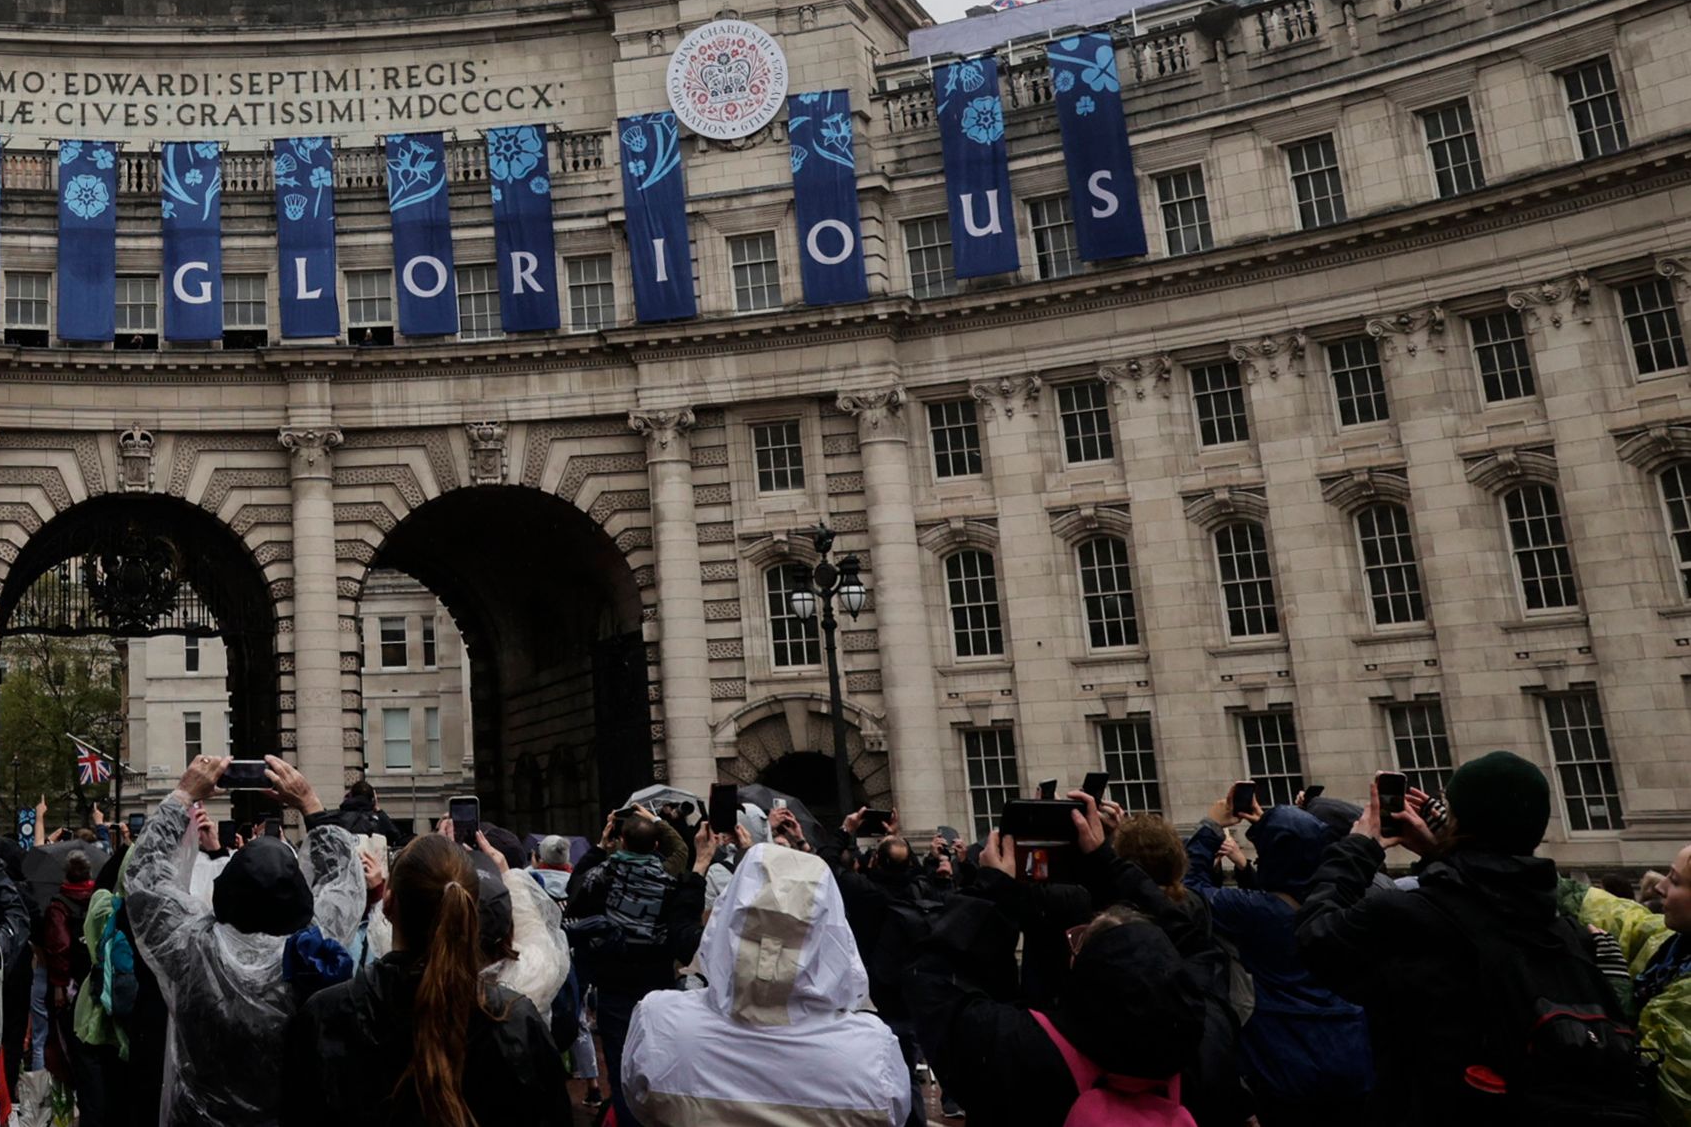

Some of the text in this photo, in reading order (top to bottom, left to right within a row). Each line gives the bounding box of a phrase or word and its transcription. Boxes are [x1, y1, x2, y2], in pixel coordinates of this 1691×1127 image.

[676, 24, 773, 66] KING CHARLES III
[63, 72, 211, 97] EDWARDI
[229, 69, 359, 96] SEPTIMI
[383, 59, 477, 91] REGIS
[740, 59, 784, 132] 6TH MAY 2023
[55, 102, 159, 127] CIVES
[176, 98, 366, 127] GRATISSIMI
[388, 83, 554, 120] MDCCCCX
[670, 77, 728, 136] CORONATION
